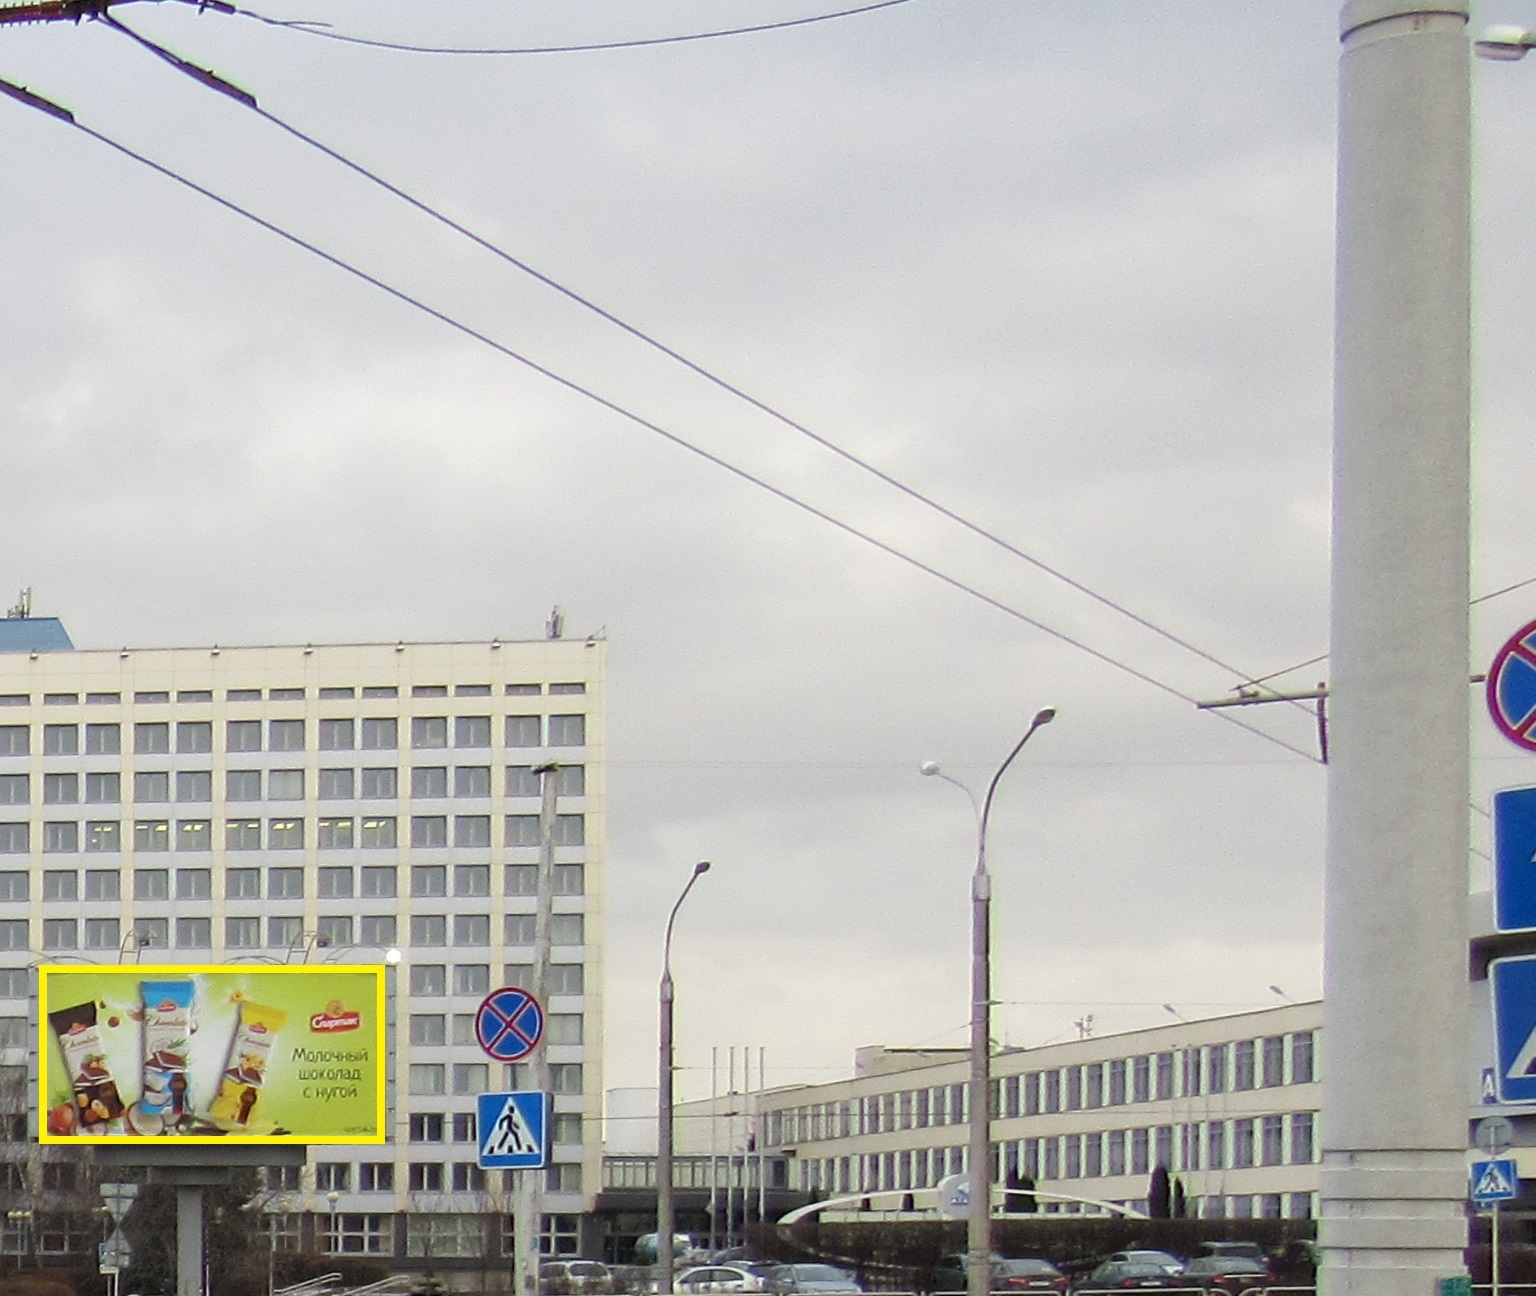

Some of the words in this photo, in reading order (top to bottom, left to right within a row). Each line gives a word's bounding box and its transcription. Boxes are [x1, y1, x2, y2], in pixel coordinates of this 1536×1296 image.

[292, 1047, 369, 1063] Молочный
[298, 1069, 362, 1081] шоколад
[316, 1084, 358, 1103] нугой
